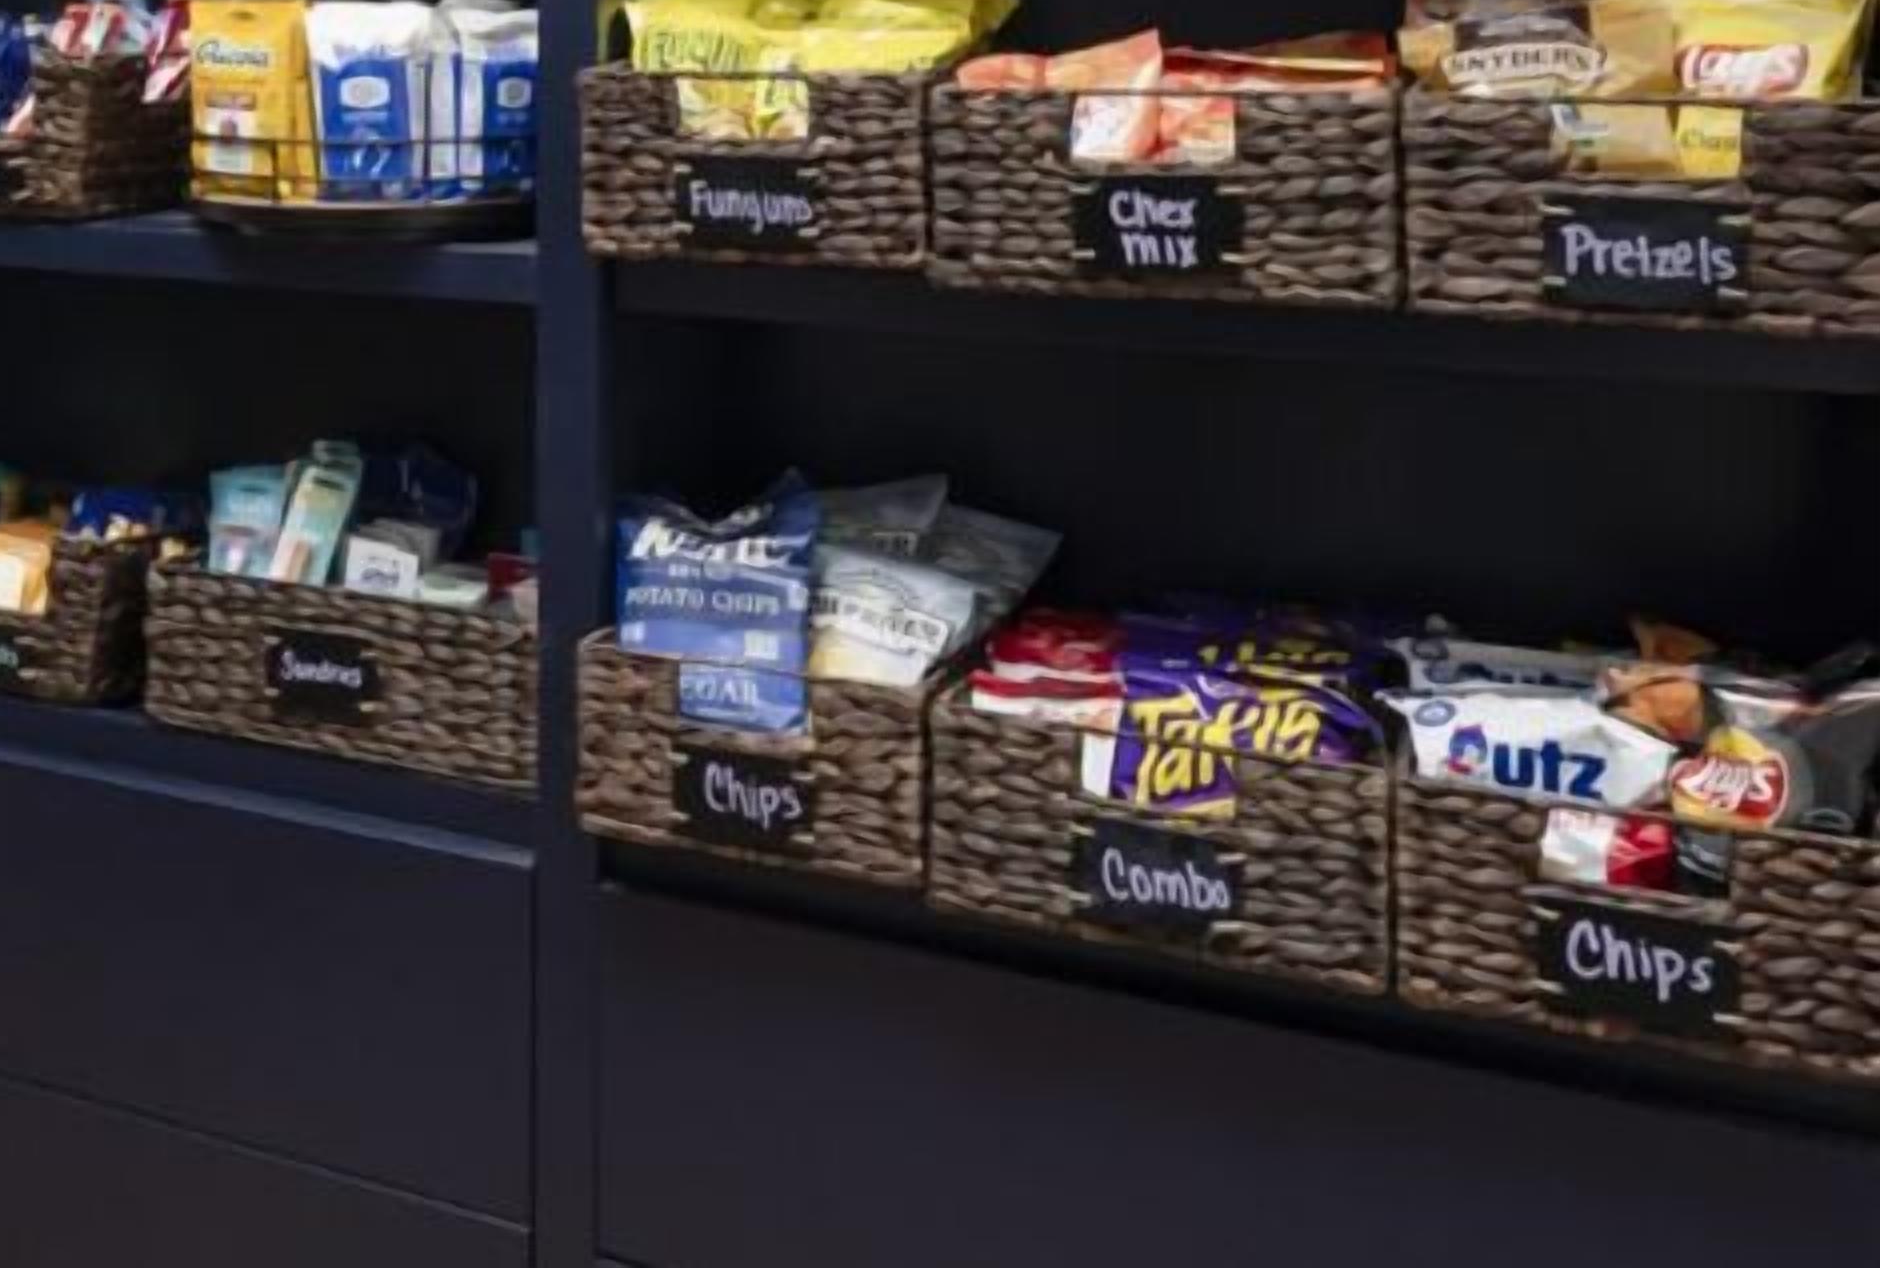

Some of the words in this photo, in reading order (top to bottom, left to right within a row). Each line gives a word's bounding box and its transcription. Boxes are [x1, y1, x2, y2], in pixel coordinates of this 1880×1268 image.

[1108, 188, 1198, 228] Chex
[1560, 223, 1737, 284] Pretzels
[704, 761, 804, 830] Chips
[1101, 845, 1231, 910] Combo
[1566, 919, 1716, 1003] Chips
